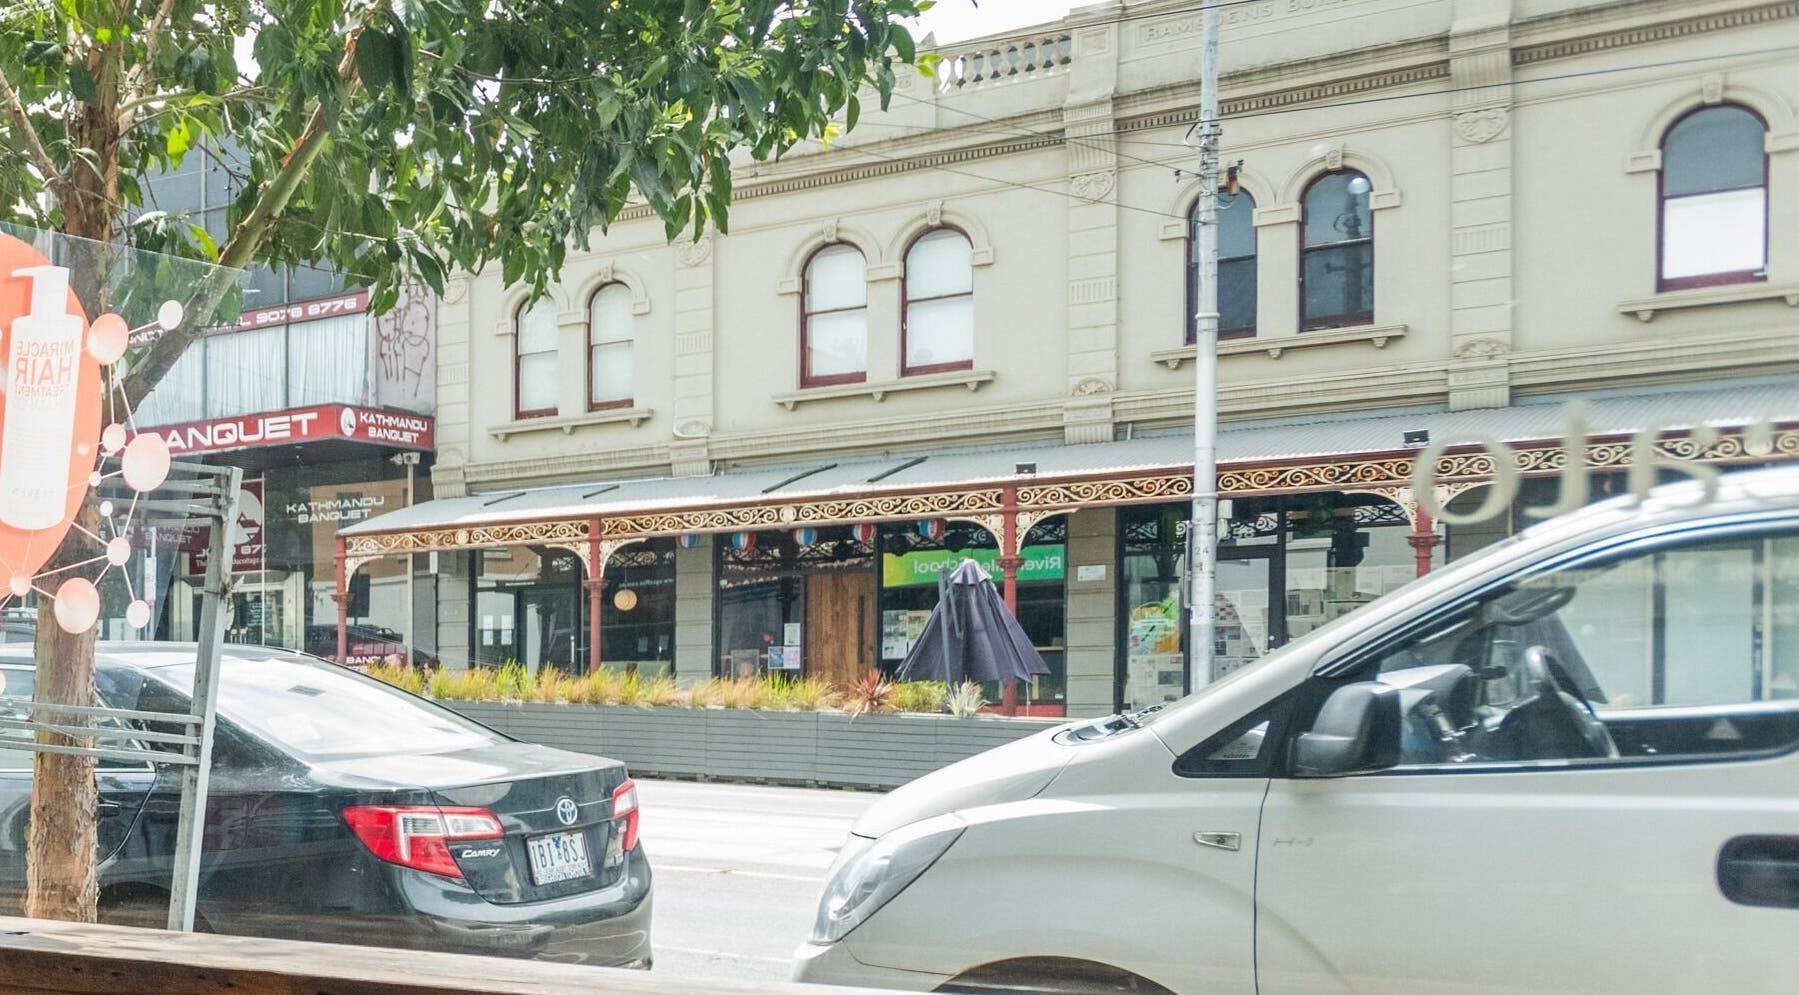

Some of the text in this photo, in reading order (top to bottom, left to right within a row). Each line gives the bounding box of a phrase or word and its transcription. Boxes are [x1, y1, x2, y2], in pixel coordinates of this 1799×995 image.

[307, 298, 358, 317] 8776
[145, 412, 319, 451] ANQUET
[359, 411, 428, 433] KATHMANDU
[367, 427, 421, 445] BANQUET
[285, 495, 385, 515] KATHMANDU
[297, 508, 373, 524] BANQUET
